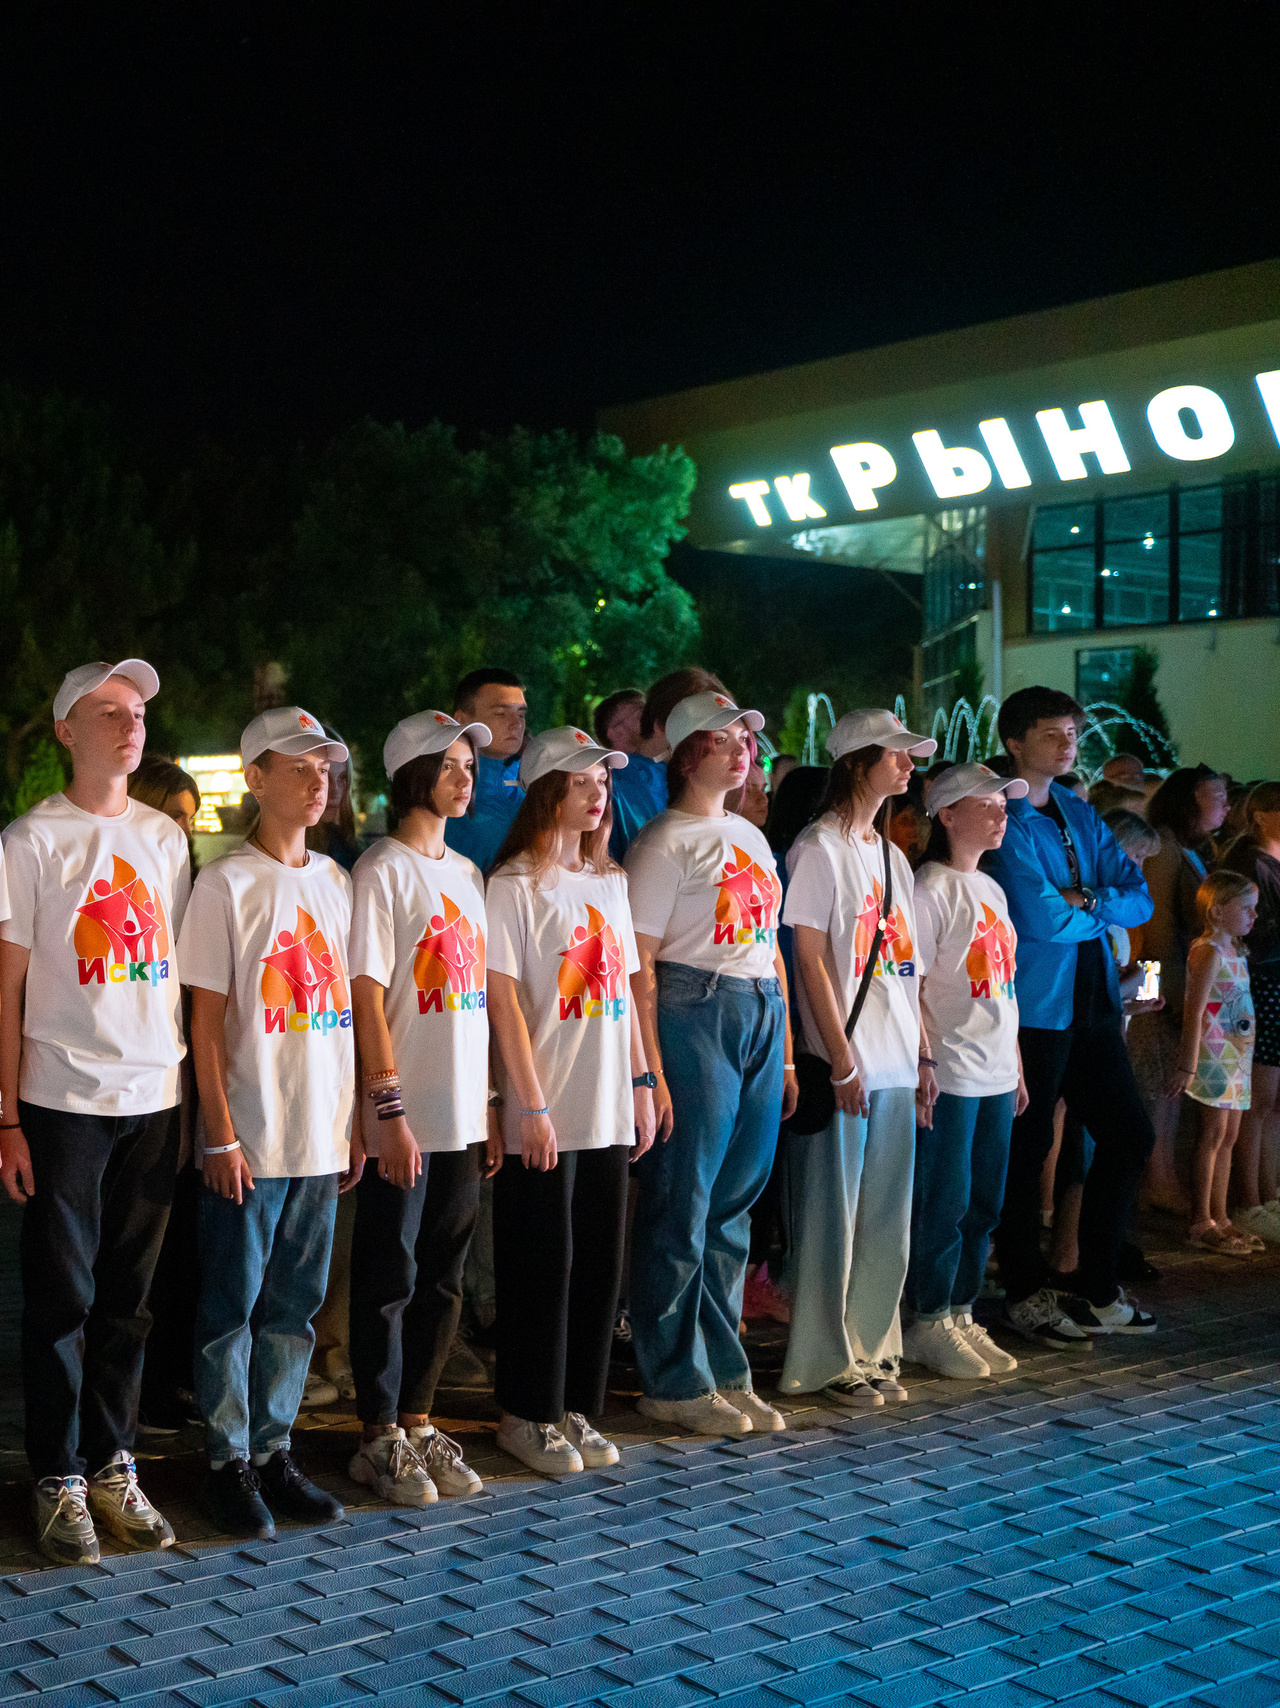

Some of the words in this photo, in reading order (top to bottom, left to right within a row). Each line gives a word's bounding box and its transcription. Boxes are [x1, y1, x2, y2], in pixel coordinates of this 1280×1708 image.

[729, 473, 827, 527] ТК
[714, 923, 777, 950] Искр
[78, 956, 169, 987] Искра
[417, 988, 486, 1016] Искра
[559, 995, 626, 1021] Искр
[264, 1007, 352, 1036] Искра
